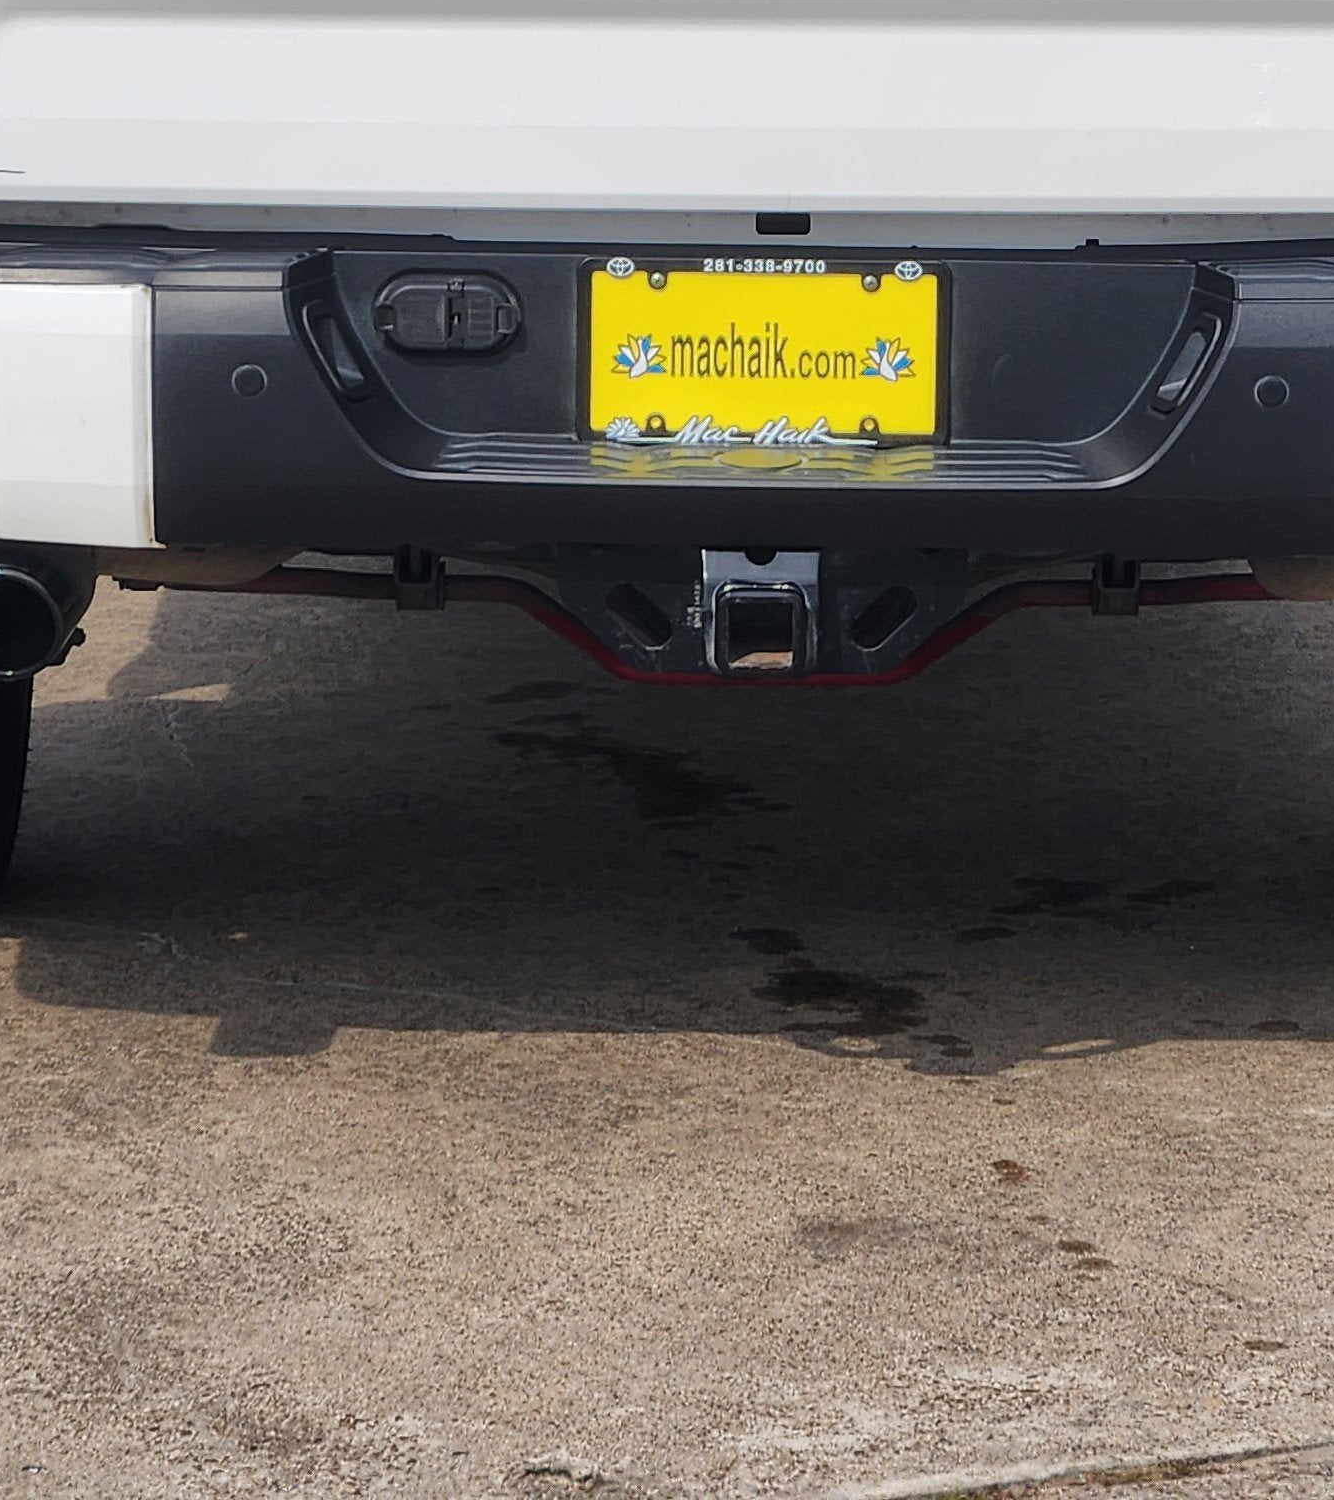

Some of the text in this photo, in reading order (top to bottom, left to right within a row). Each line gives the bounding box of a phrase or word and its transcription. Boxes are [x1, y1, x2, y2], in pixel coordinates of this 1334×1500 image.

[704, 258, 827, 274] 281-338-9700
[670, 322, 856, 378] machaik.com
[639, 415, 877, 446] Mac Haik
